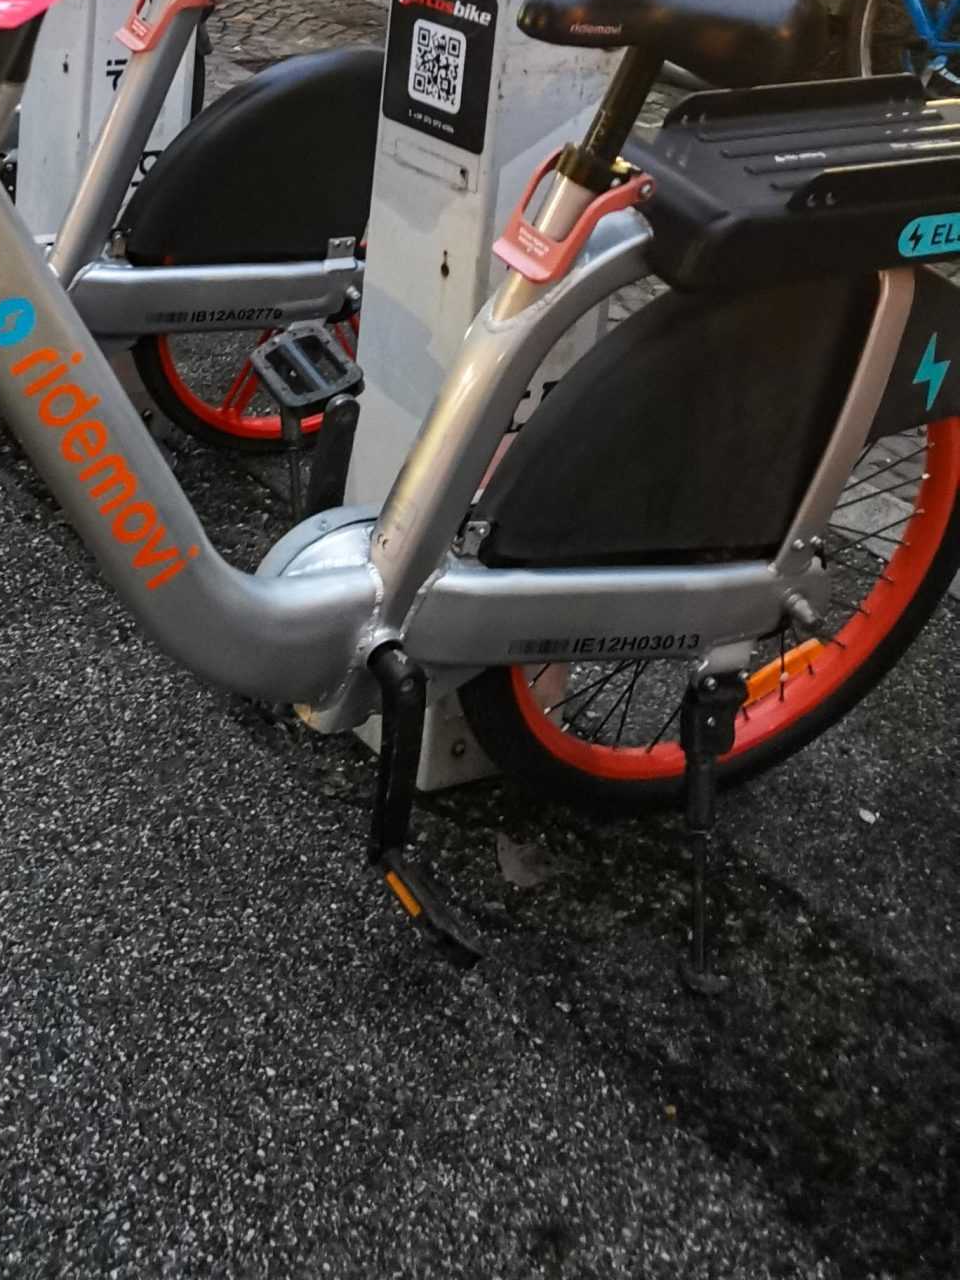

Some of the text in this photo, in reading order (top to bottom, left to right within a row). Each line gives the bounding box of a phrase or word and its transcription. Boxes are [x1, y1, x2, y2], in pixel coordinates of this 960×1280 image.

[930, 223, 960, 247] EL
[9, 346, 201, 591] ridemovi
[572, 634, 701, 654] IE12H03013
